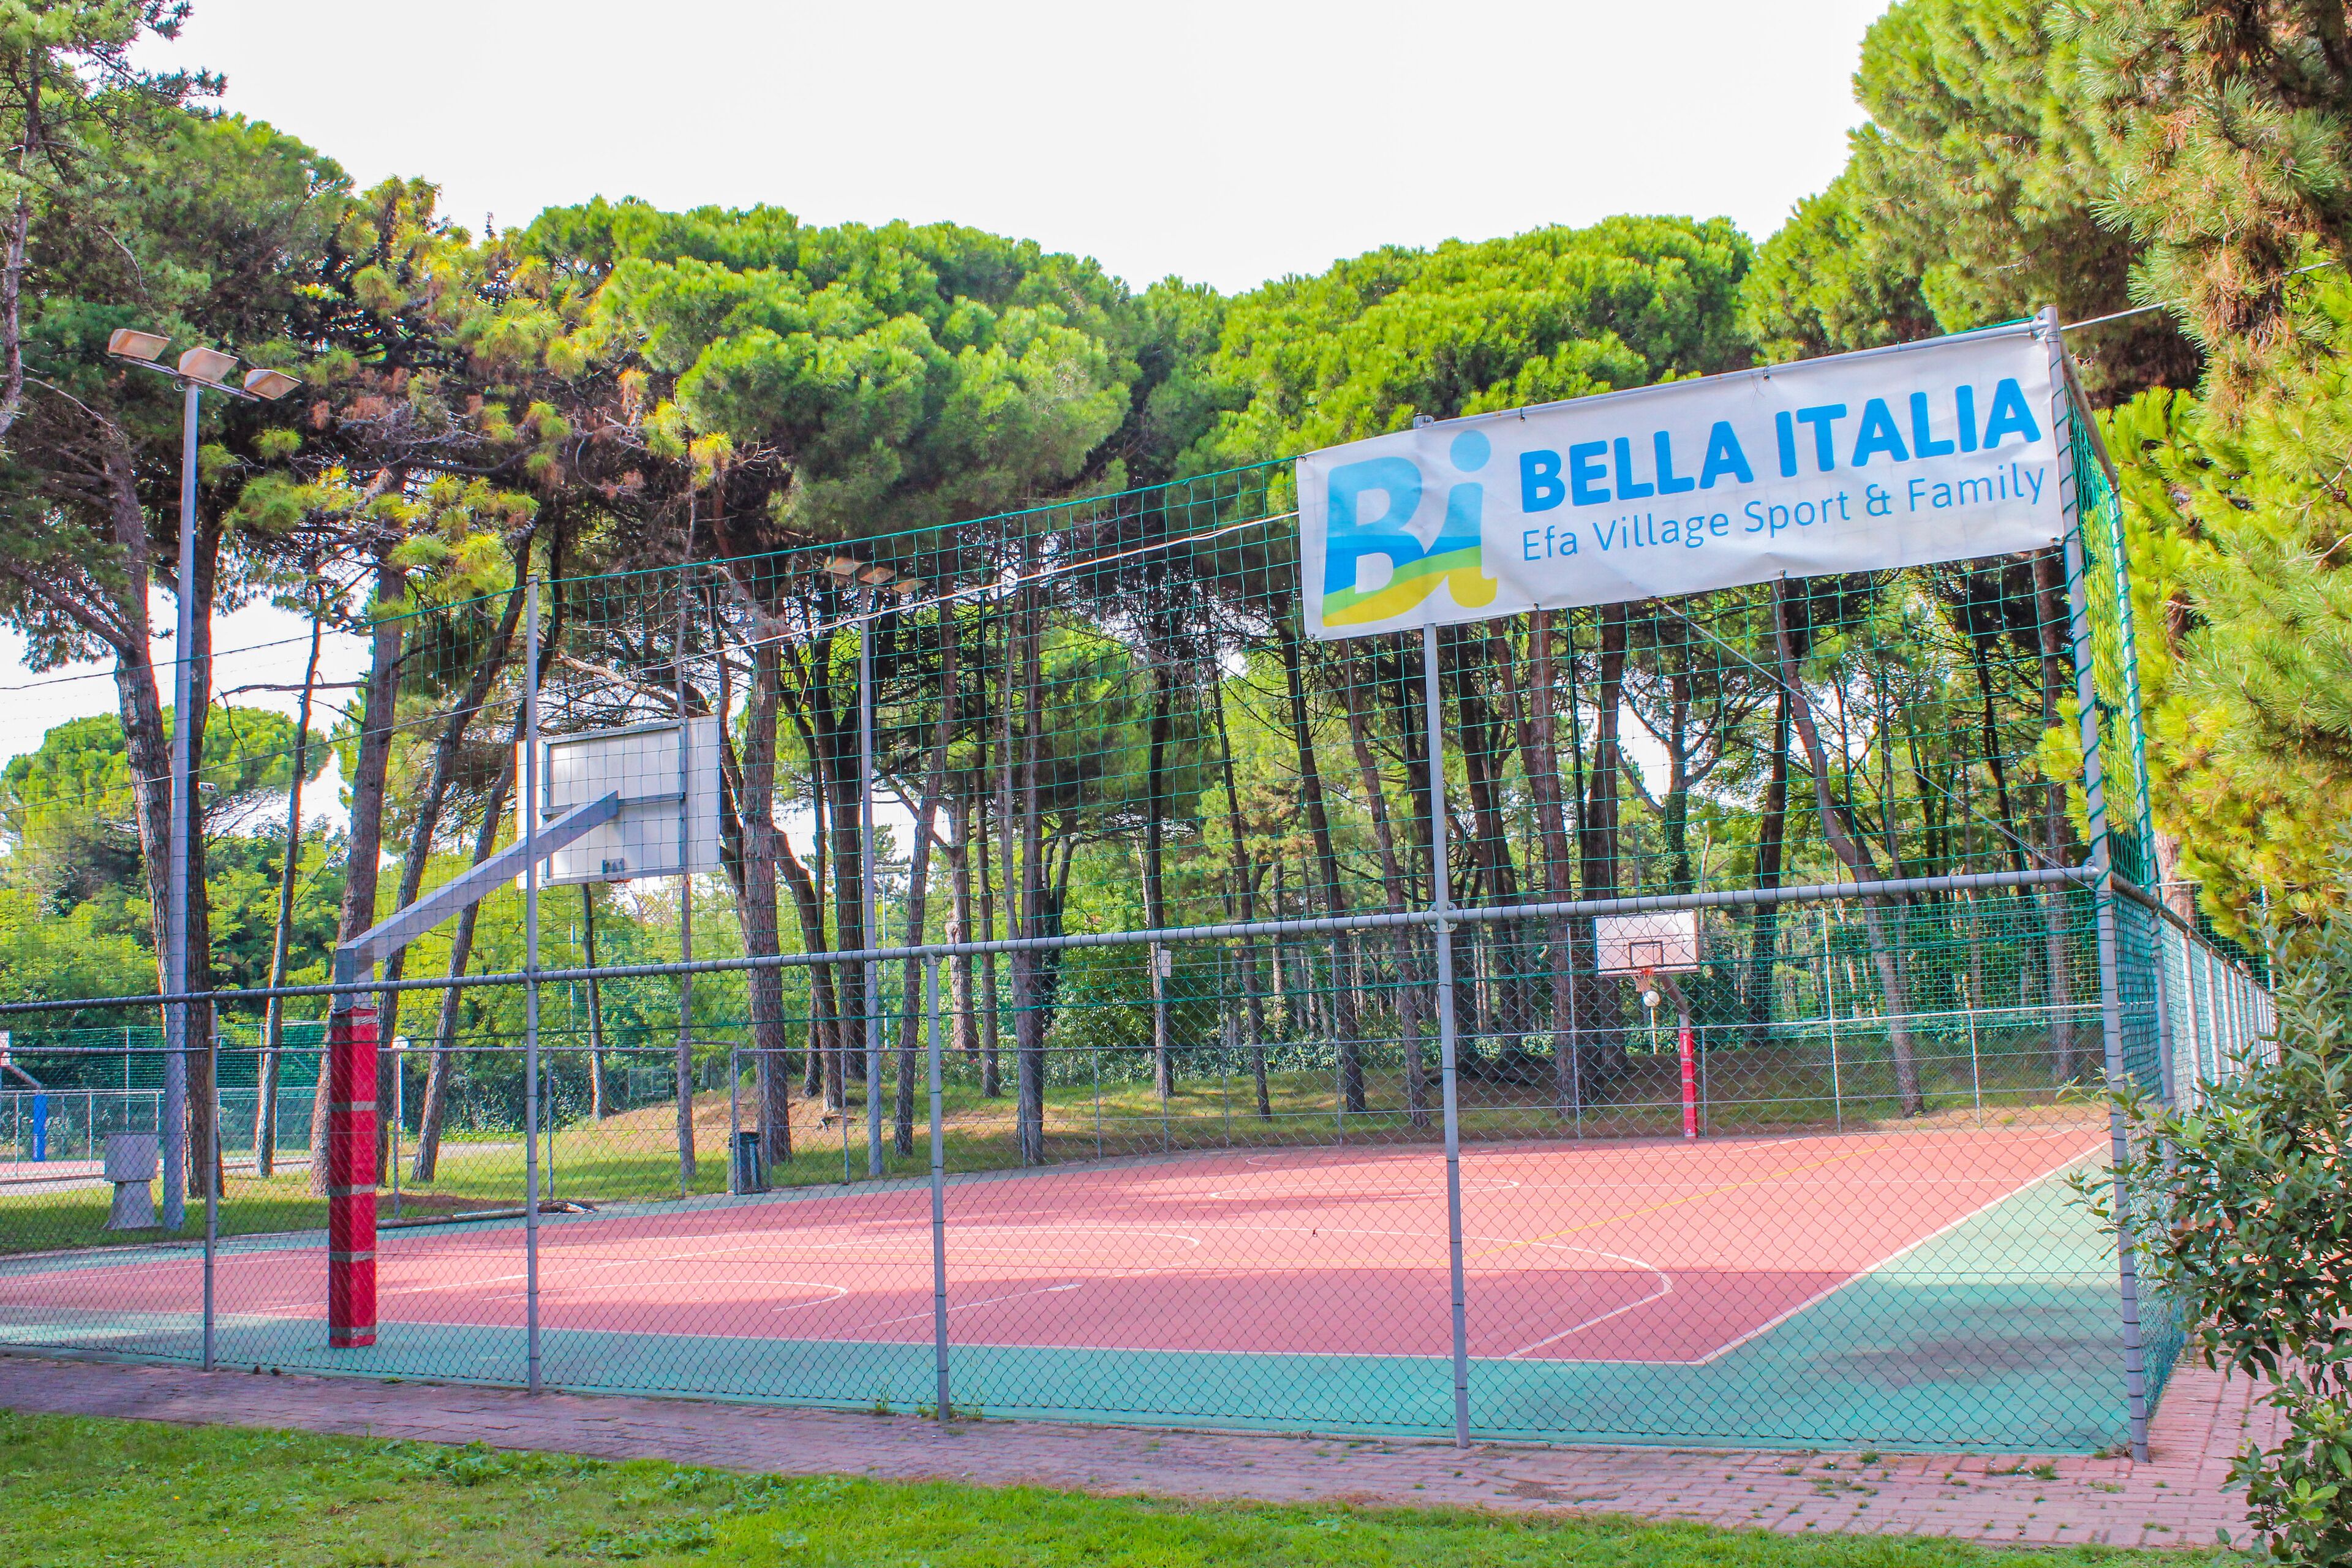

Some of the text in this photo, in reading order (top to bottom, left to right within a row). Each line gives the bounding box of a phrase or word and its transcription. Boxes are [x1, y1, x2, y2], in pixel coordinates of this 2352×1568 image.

[1519, 377, 2043, 514] BELLA ITALIA
[1523, 461, 2046, 562] Efa Village Sport & Family
[1322, 429, 1498, 627] Bi
